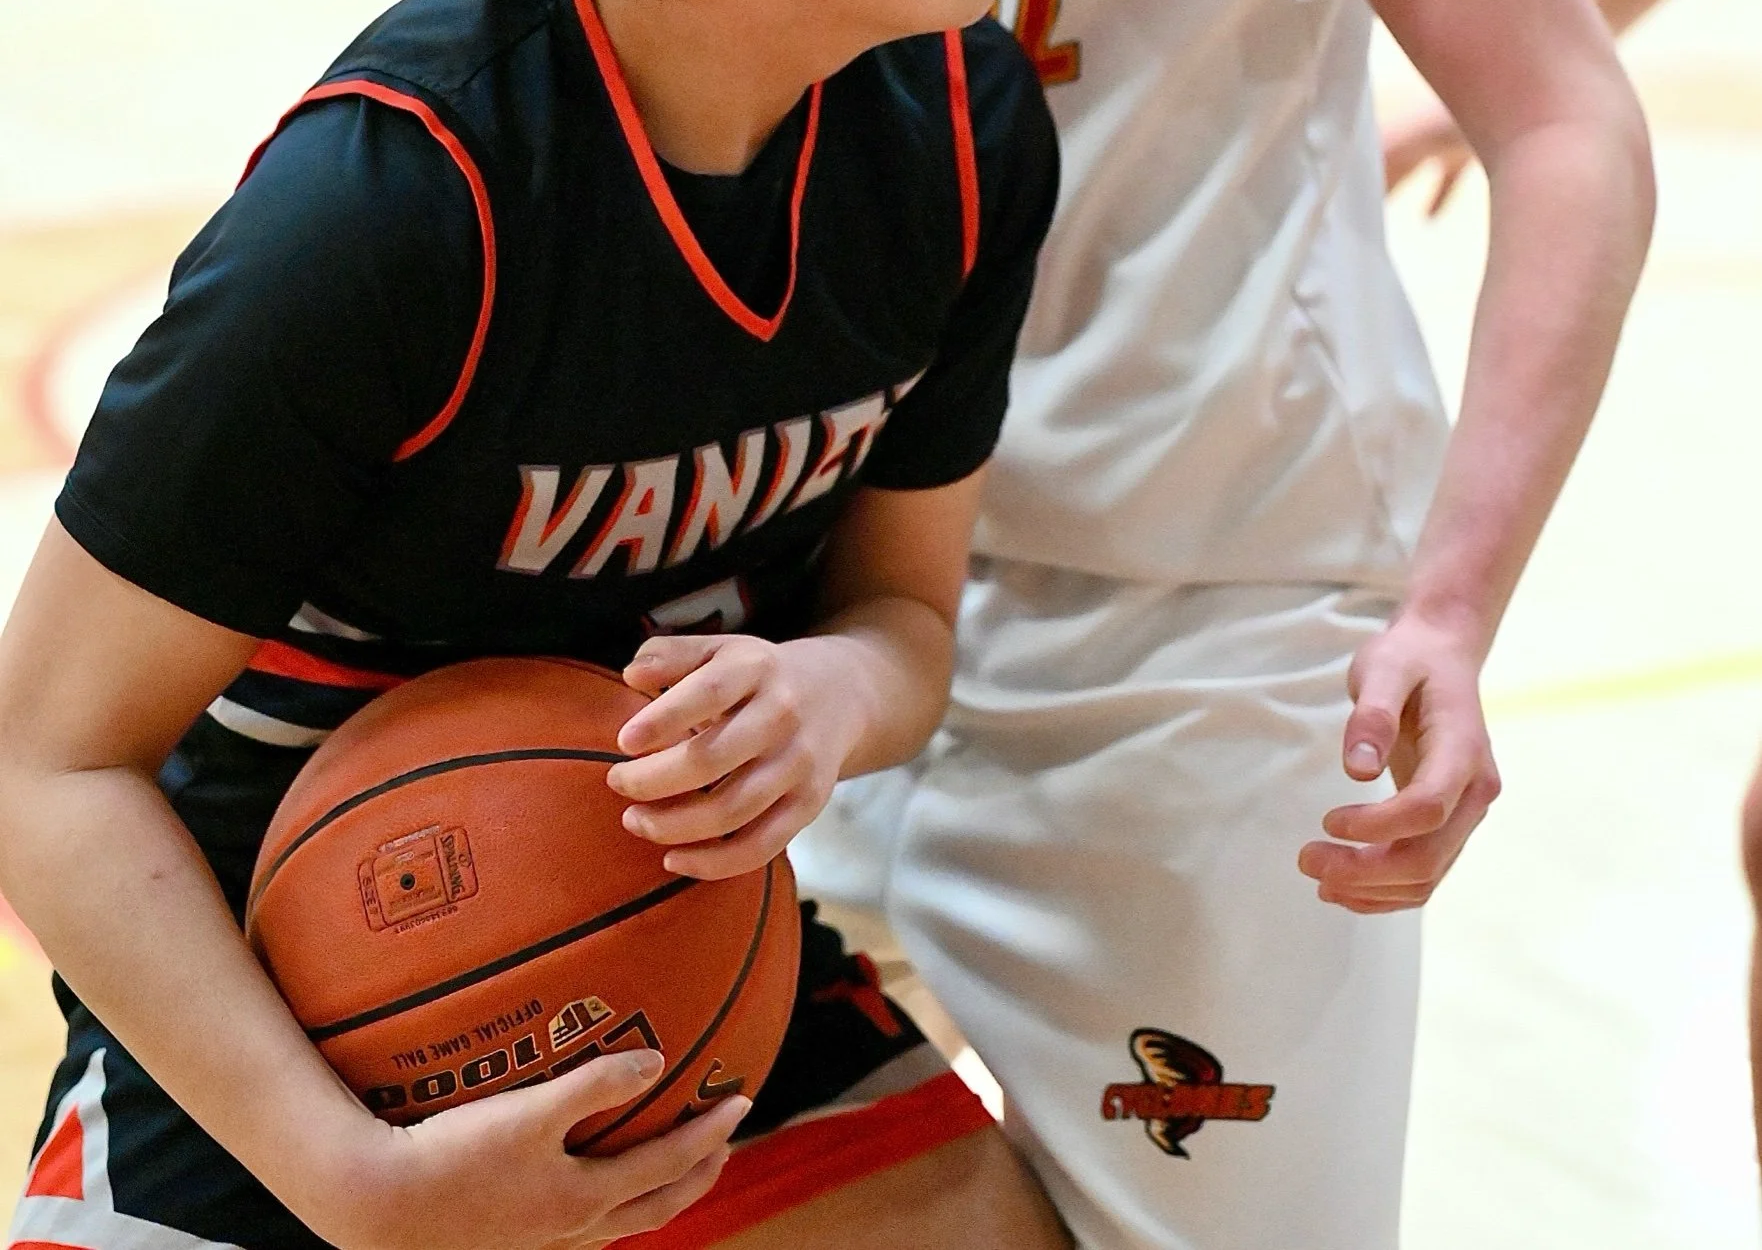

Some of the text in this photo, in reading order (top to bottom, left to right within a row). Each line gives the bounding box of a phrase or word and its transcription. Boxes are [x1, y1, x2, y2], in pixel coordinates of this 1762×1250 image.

[496, 366, 928, 580] VANIE
[362, 877, 377, 907] SIZE
[440, 834, 466, 900] SPALDING
[390, 999, 544, 1070] OFFICIAL GAME BALL
